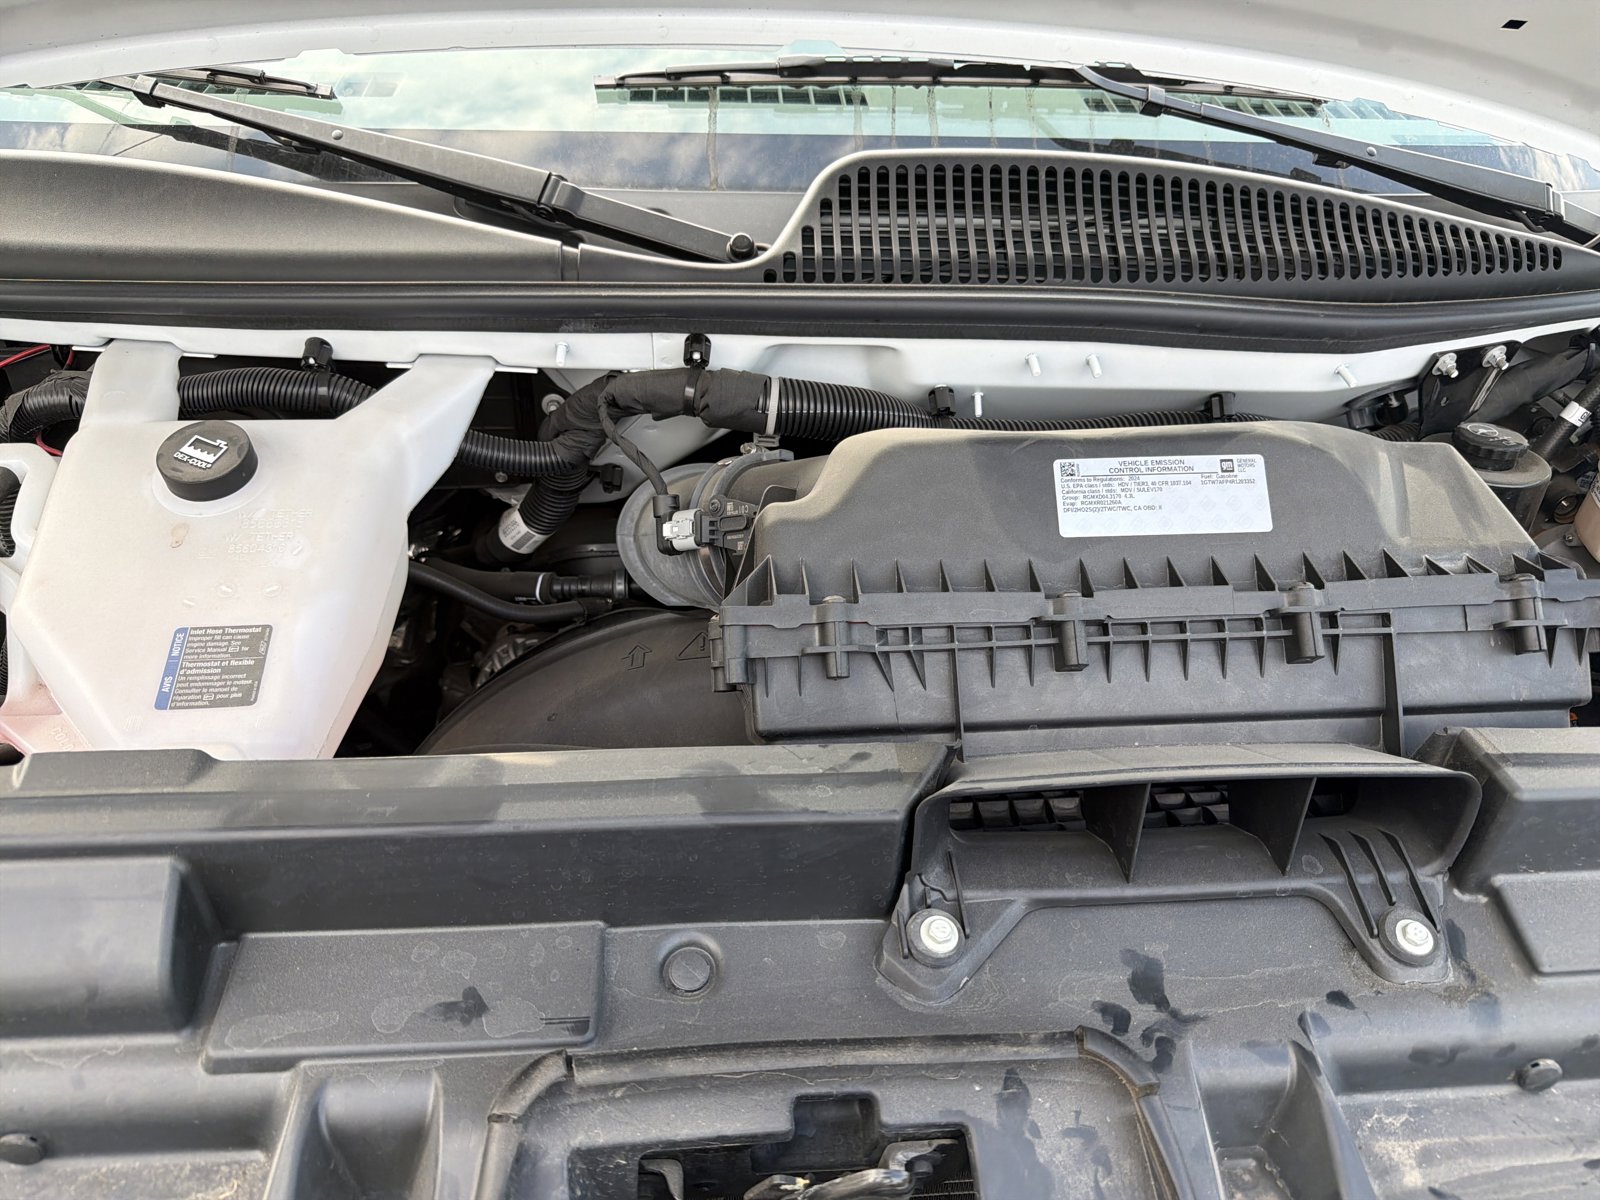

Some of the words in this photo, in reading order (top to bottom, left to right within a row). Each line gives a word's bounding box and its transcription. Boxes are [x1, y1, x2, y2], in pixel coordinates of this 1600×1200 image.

[1118, 459, 1149, 467] VEHICLE
[171, 632, 185, 657] NOTICE
[182, 659, 221, 668] Thermostat
[161, 675, 173, 693] AVIS
